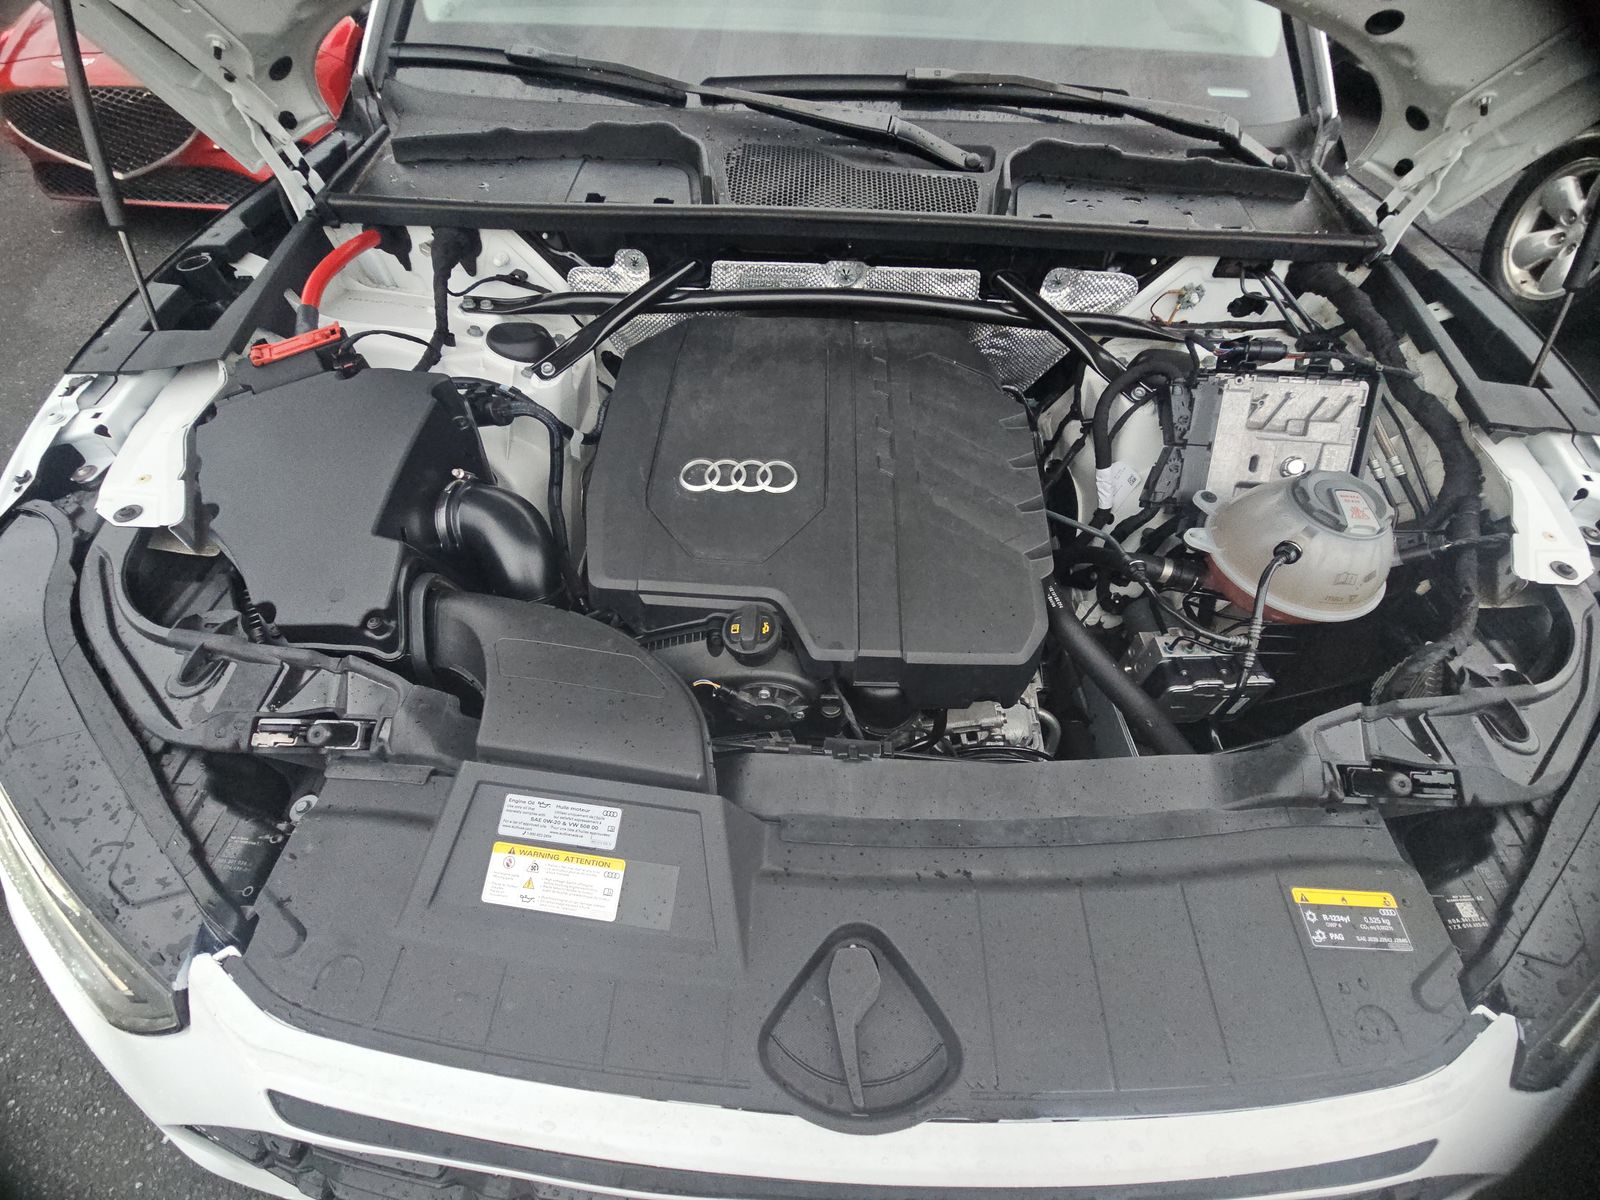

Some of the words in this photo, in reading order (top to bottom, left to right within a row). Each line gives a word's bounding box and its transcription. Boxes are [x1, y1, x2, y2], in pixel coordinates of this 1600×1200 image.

[519, 849, 560, 860] WARNING
[564, 856, 611, 868] ATTENTION
[1322, 914, 1351, 923] R-1234yf
